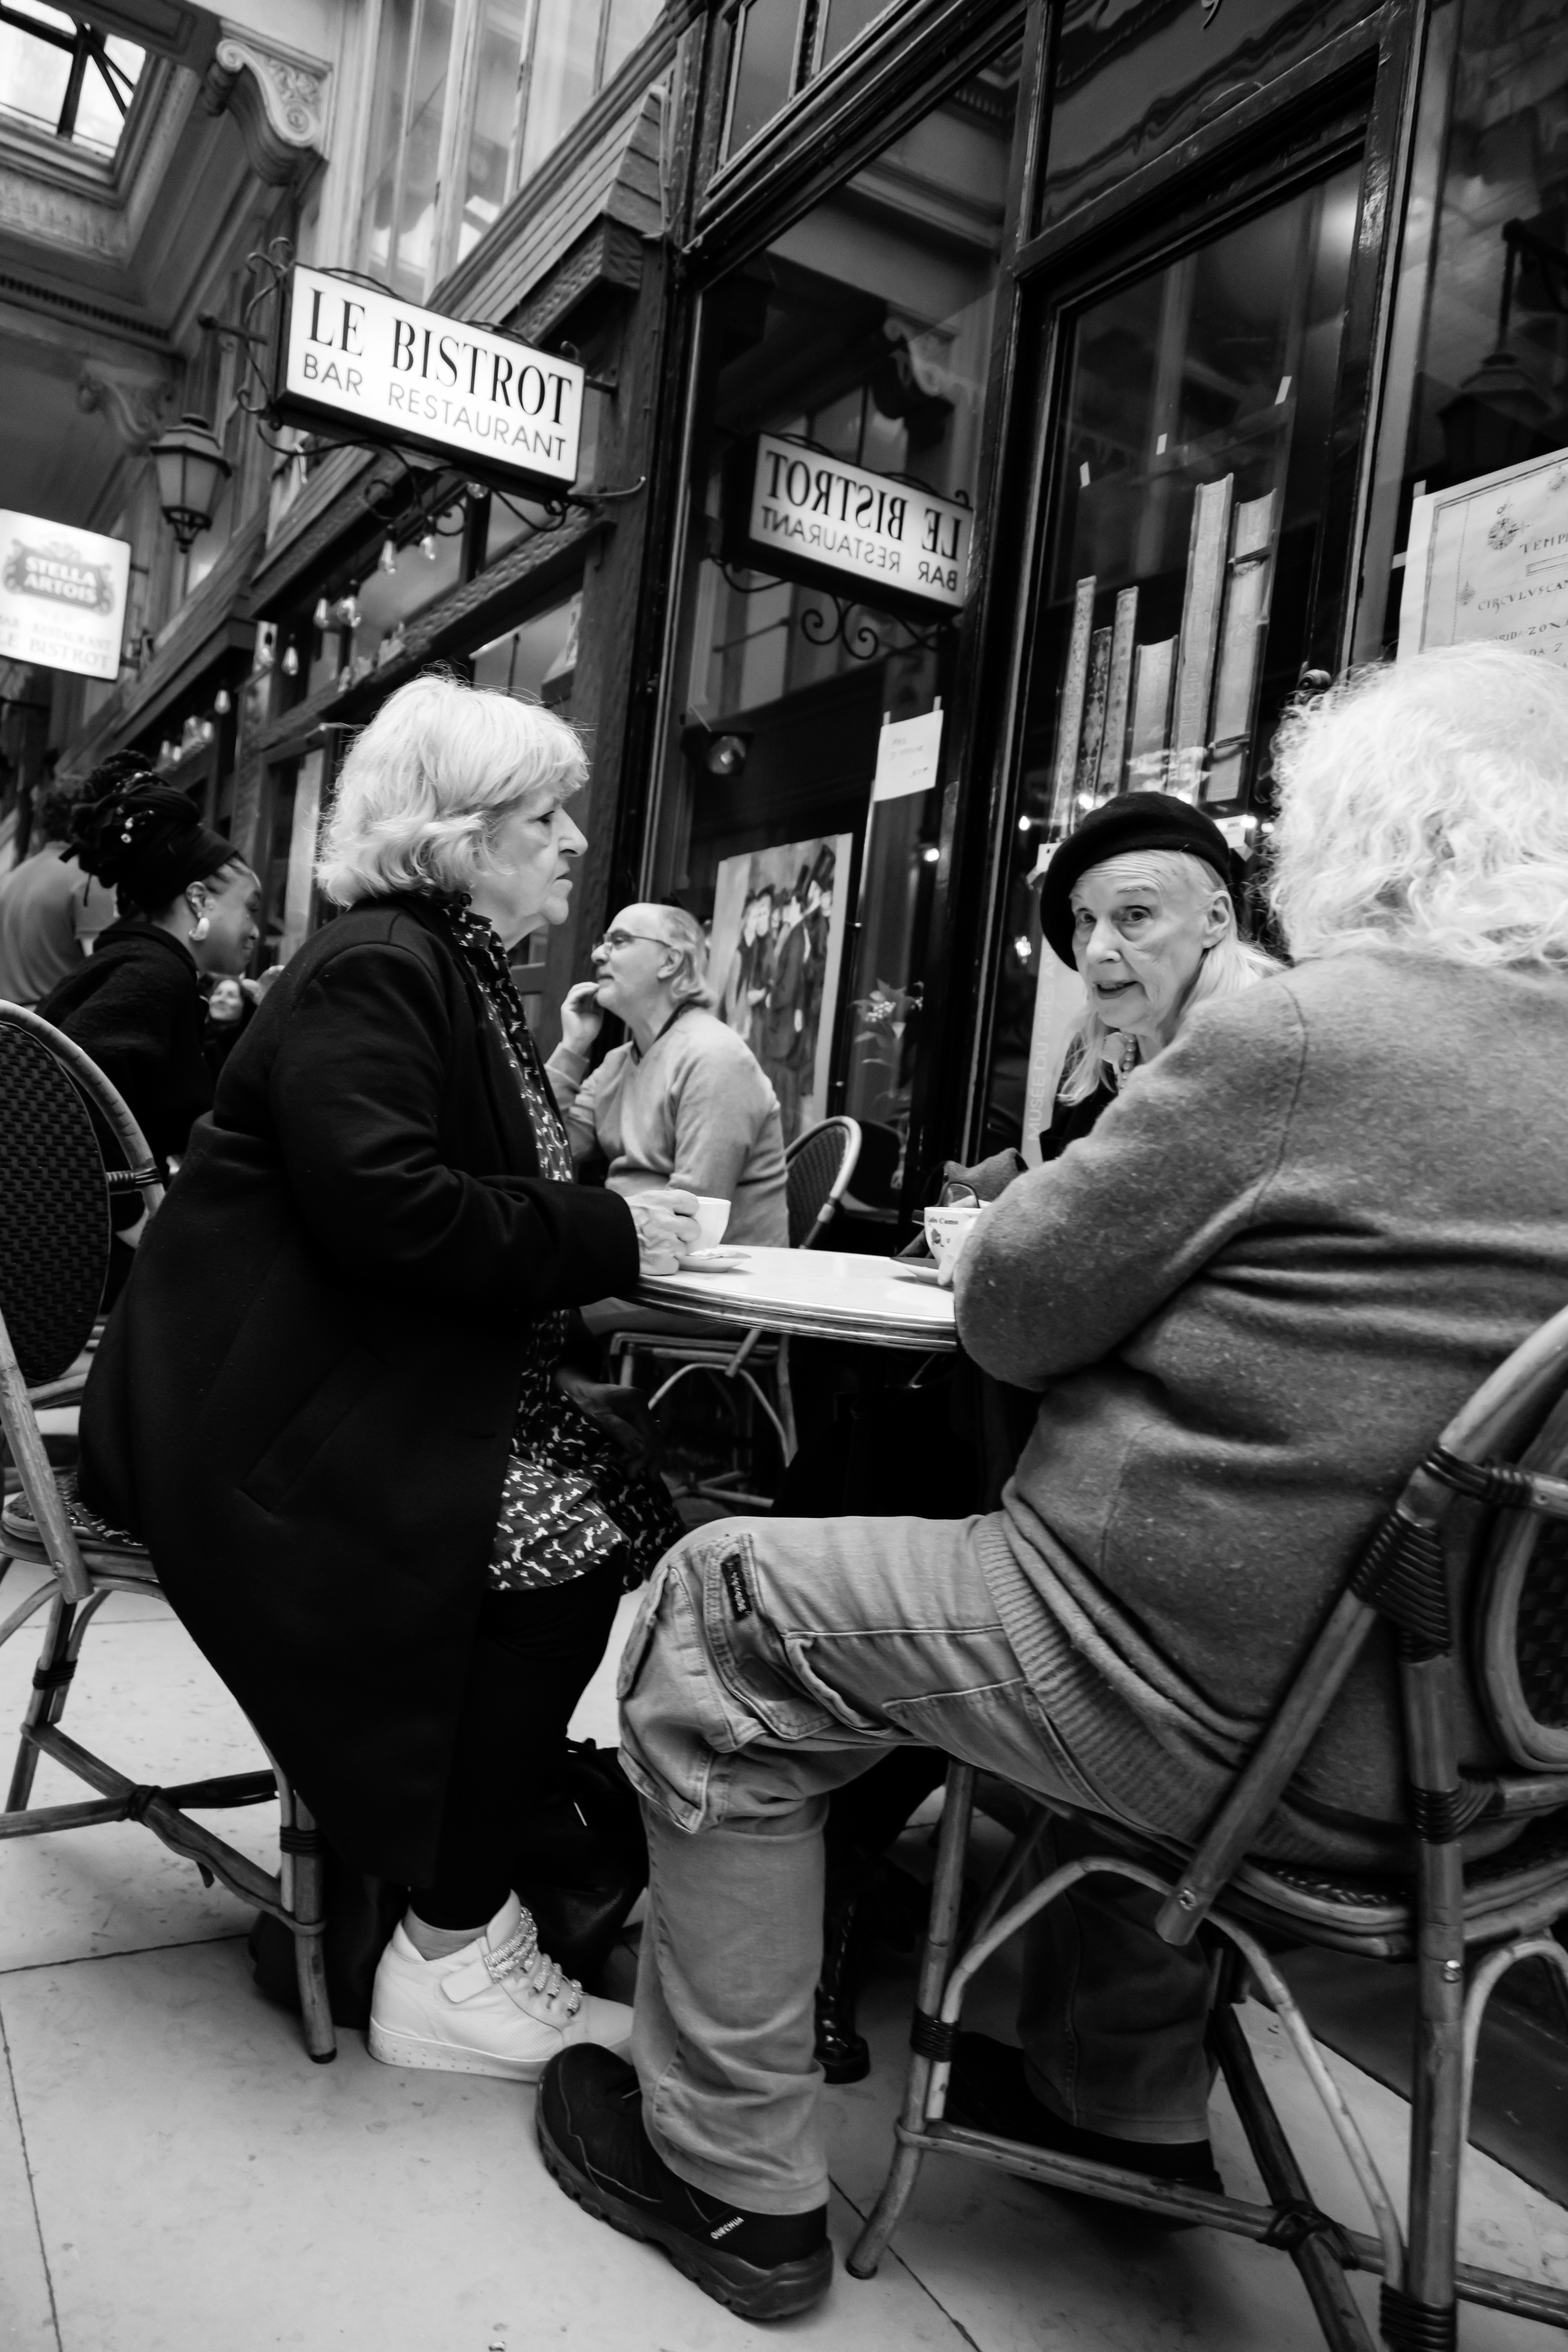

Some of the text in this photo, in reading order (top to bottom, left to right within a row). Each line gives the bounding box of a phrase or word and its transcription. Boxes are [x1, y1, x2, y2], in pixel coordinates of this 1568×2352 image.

[307, 288, 572, 425] LE BISTROT
[304, 353, 566, 461] BAR RESTAURANT
[23, 572, 98, 604] ARTOIS
[25, 556, 97, 588] STELLA
[30, 637, 111, 670] BISTROT
[1034, 1042, 1049, 1070] DU
